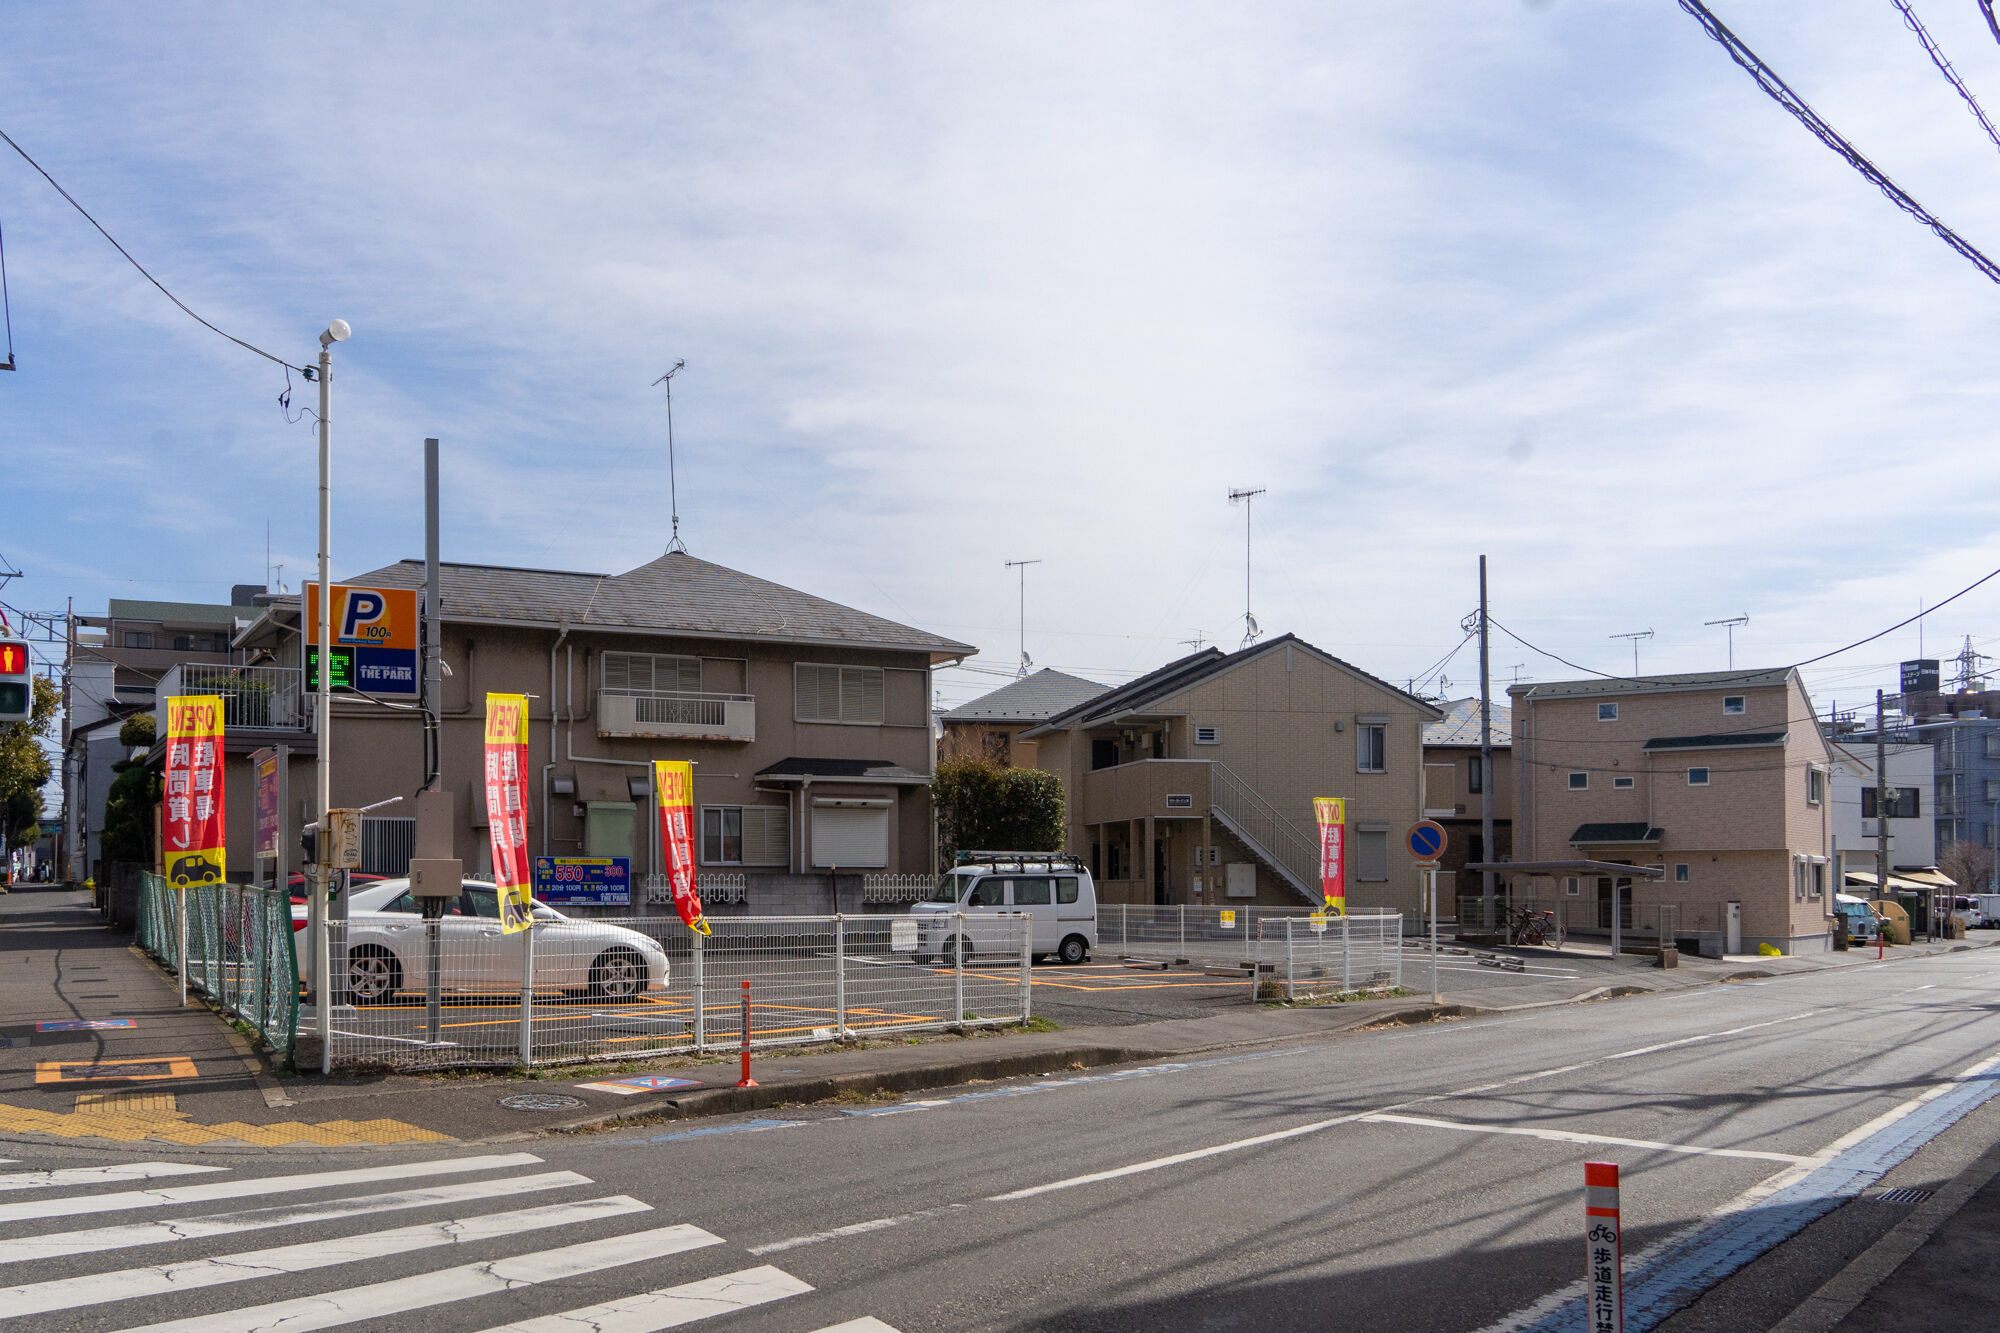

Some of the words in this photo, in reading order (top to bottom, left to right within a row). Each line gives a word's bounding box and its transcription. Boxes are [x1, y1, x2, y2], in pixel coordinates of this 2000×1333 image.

[339, 589, 387, 638] P
[365, 626, 392, 639] 100円
[360, 668, 381, 679] THE
[383, 669, 413, 681] PARK
